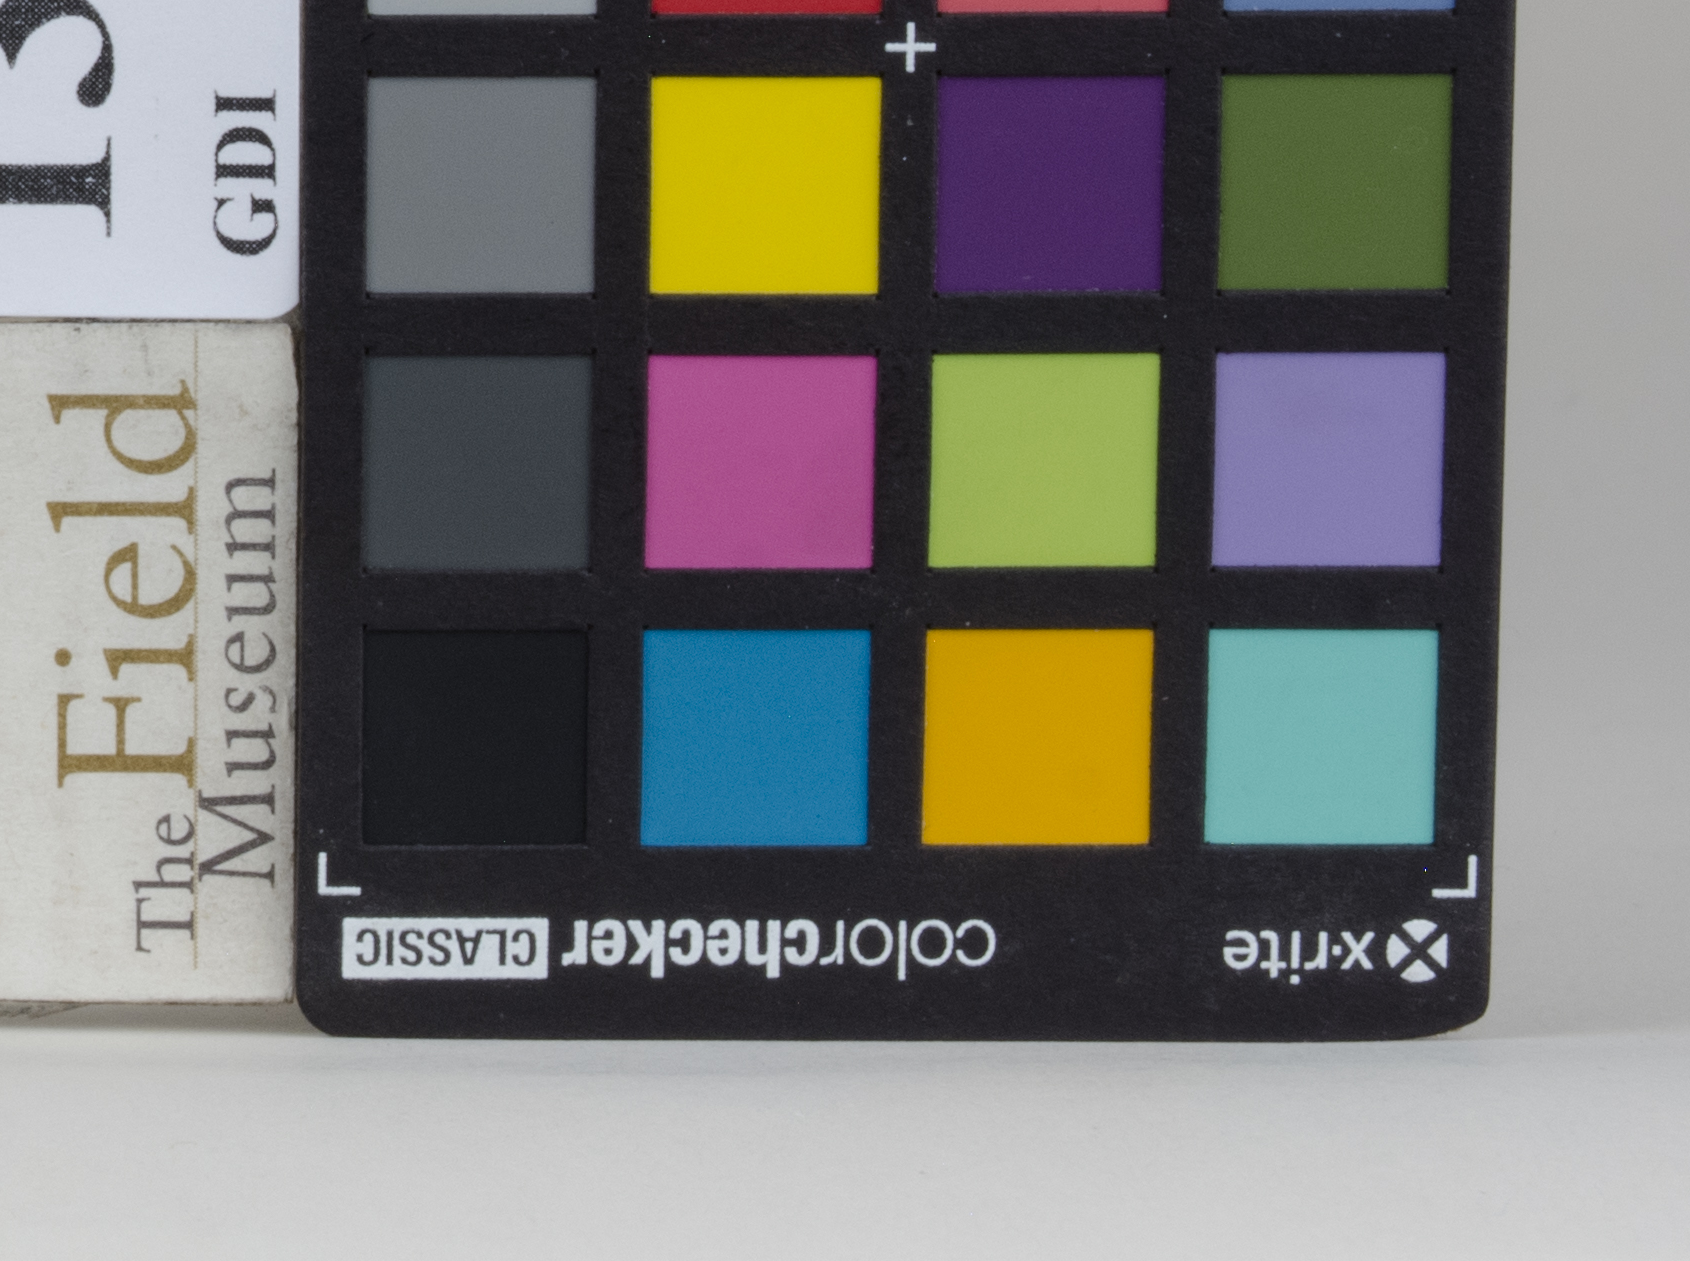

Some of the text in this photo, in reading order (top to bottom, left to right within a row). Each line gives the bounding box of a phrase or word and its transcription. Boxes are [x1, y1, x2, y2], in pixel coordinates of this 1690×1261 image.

[214, 93, 279, 257] GDI
[46, 379, 199, 953] The Field
[197, 467, 278, 889] Museum
[355, 918, 998, 982] colorchecker CLASSIC
